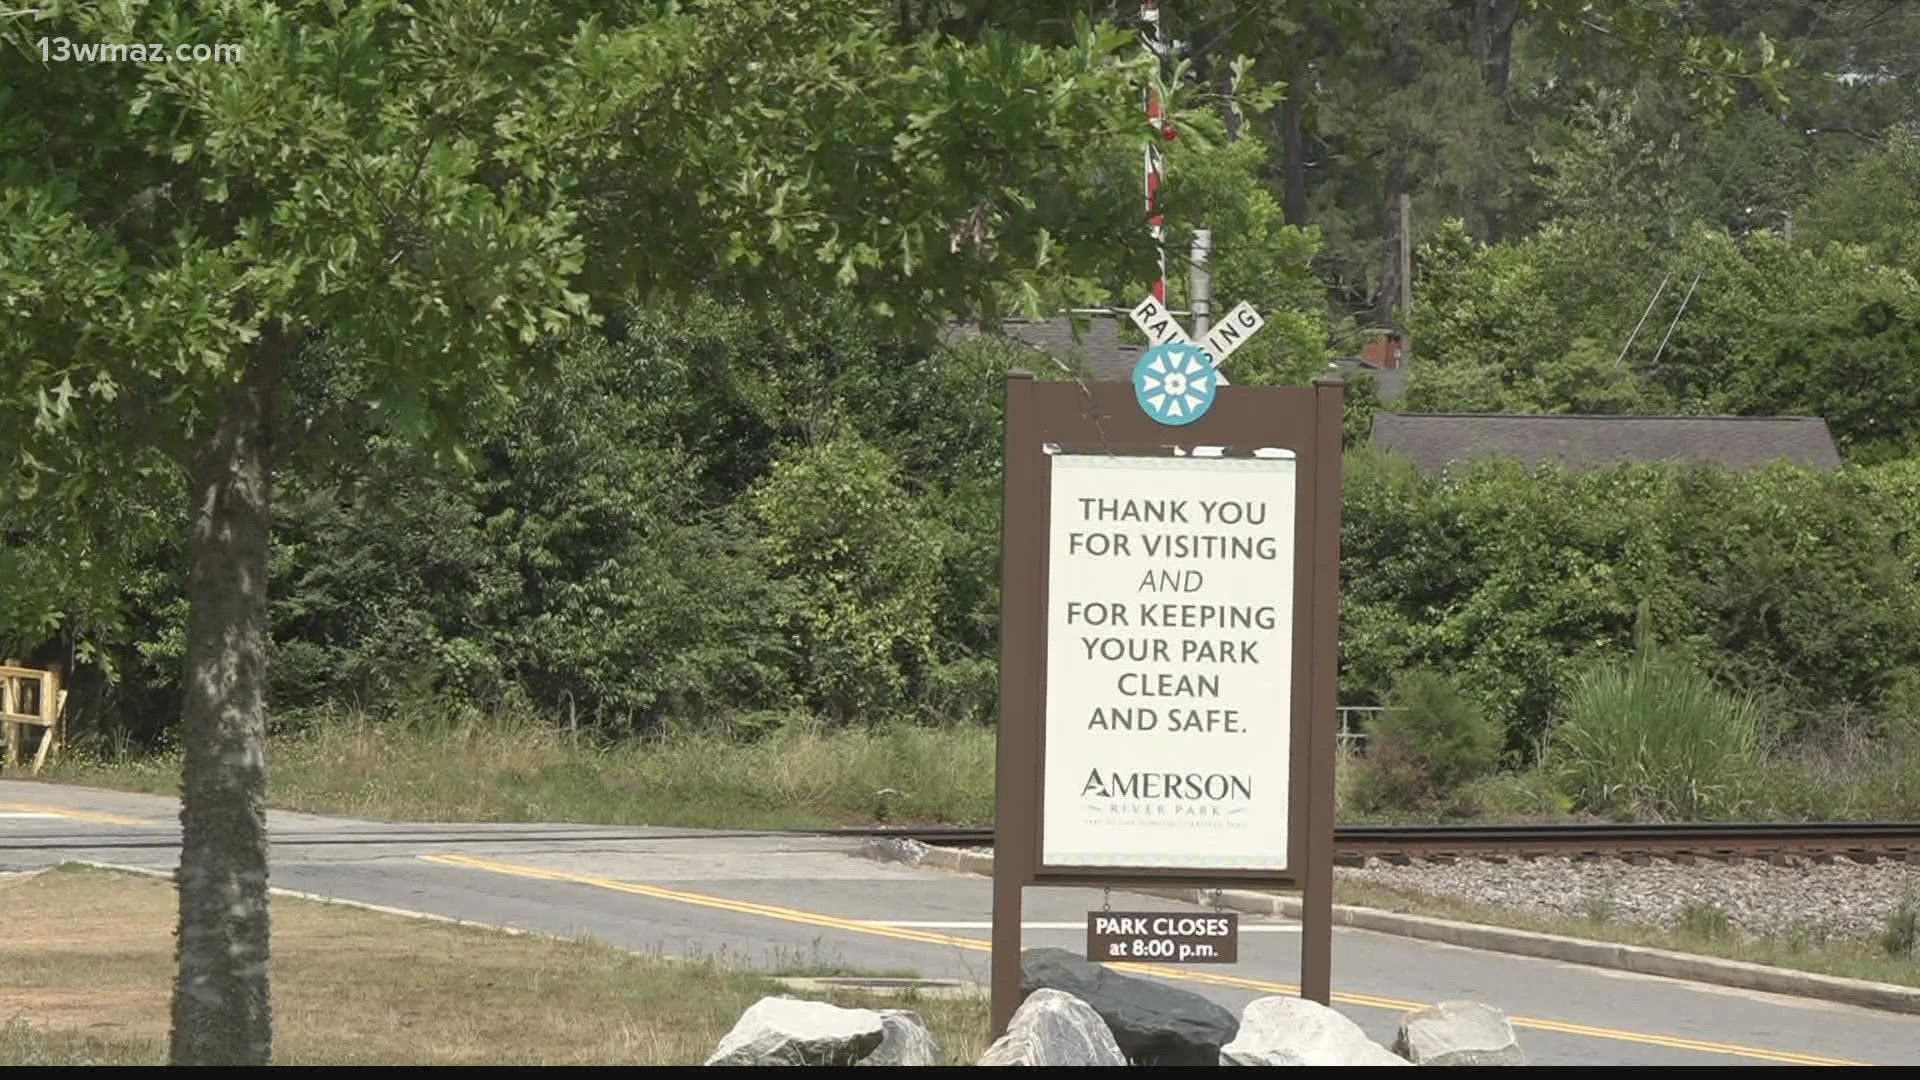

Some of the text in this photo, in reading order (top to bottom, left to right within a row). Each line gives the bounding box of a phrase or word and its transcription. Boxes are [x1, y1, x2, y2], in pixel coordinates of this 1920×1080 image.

[1079, 498, 1267, 525] THANK YOU
[1069, 533, 1277, 560] FOR VISITING
[1138, 569, 1204, 593] AND
[1067, 602, 1276, 630] FOR KEEPING
[1081, 637, 1260, 664] YOUR PARK
[1117, 673, 1220, 698] CLEAN
[1088, 707, 1247, 734] AND SAFE.
[1081, 767, 1252, 801] AMERSON
[1110, 804, 1221, 817] RIVER PARK
[1096, 917, 1229, 936] PARK CLOSES
[1109, 940, 1219, 961] at 8:00 p.m.
